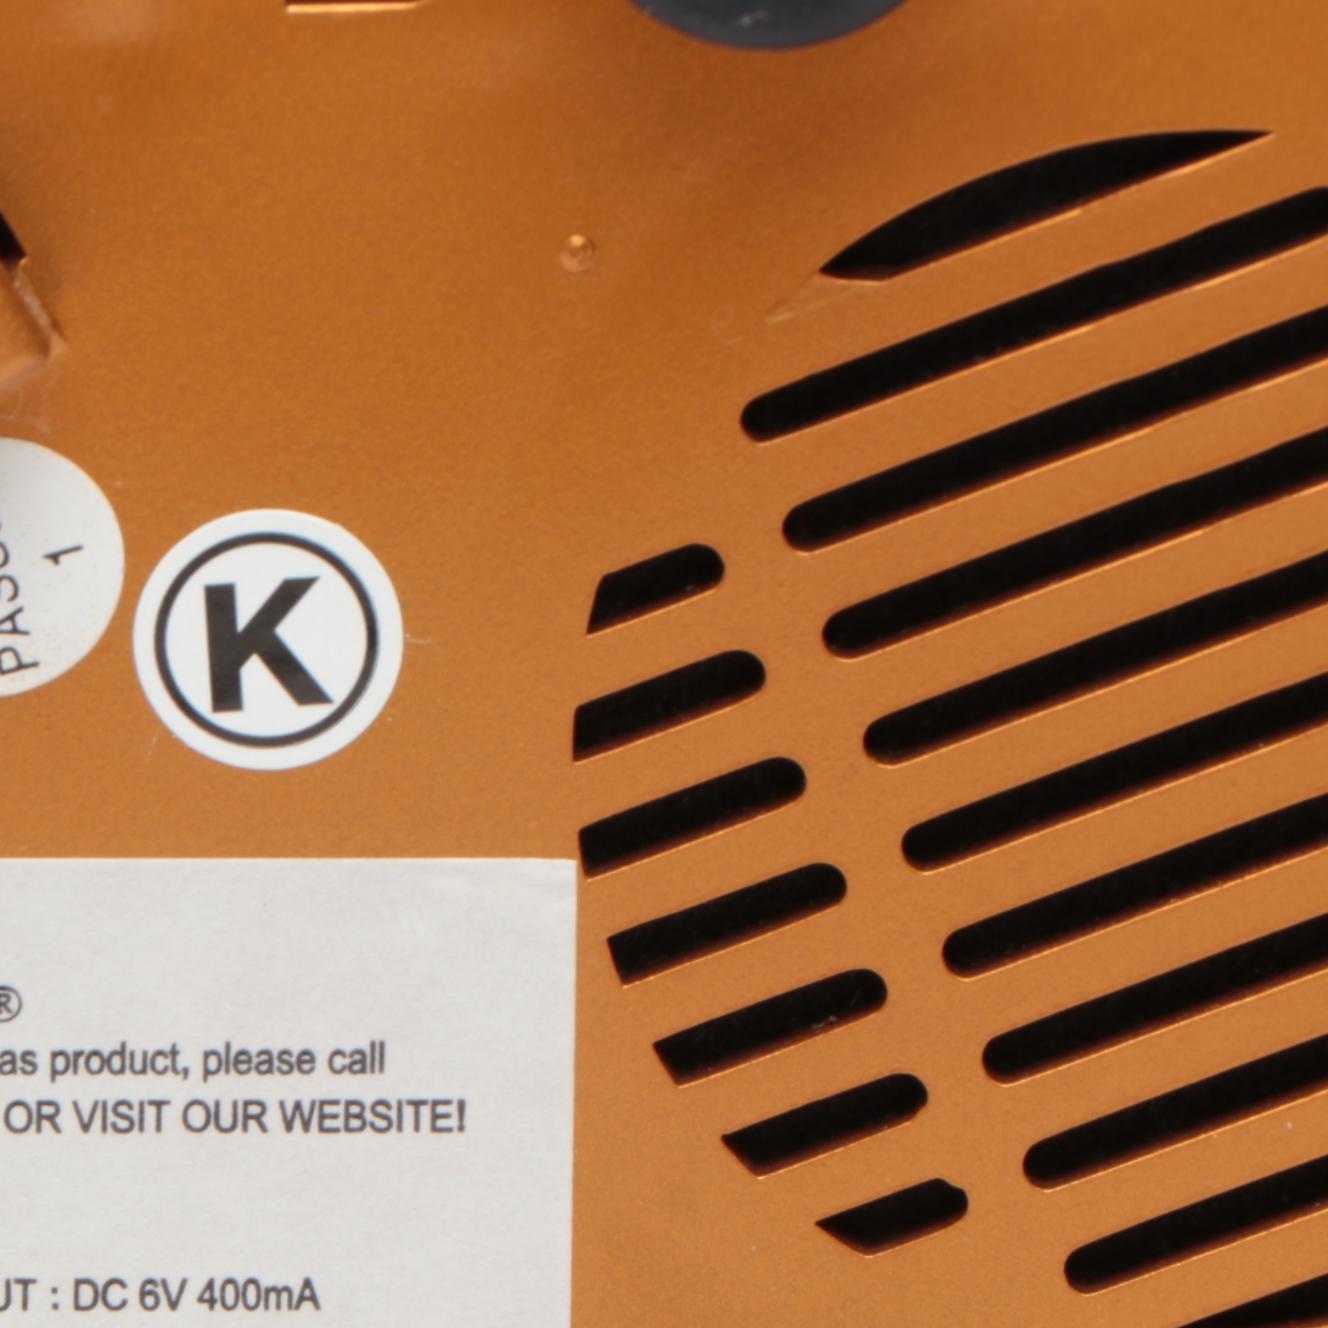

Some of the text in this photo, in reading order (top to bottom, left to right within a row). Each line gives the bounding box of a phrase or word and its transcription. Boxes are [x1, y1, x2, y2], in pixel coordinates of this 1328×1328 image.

[44, 543, 83, 568] 1
[204, 576, 333, 713] K
[51, 1042, 188, 1082] product,
[204, 1042, 315, 1082] please
[328, 1041, 384, 1074] call
[4, 1100, 60, 1133] OR
[74, 1100, 170, 1133] VISIT
[183, 1100, 267, 1133] OUR
[280, 1100, 465, 1133] WEBSITE!
[74, 1278, 127, 1311] DC
[140, 1279, 187, 1310] 6V
[198, 1278, 320, 1311] 400mA
